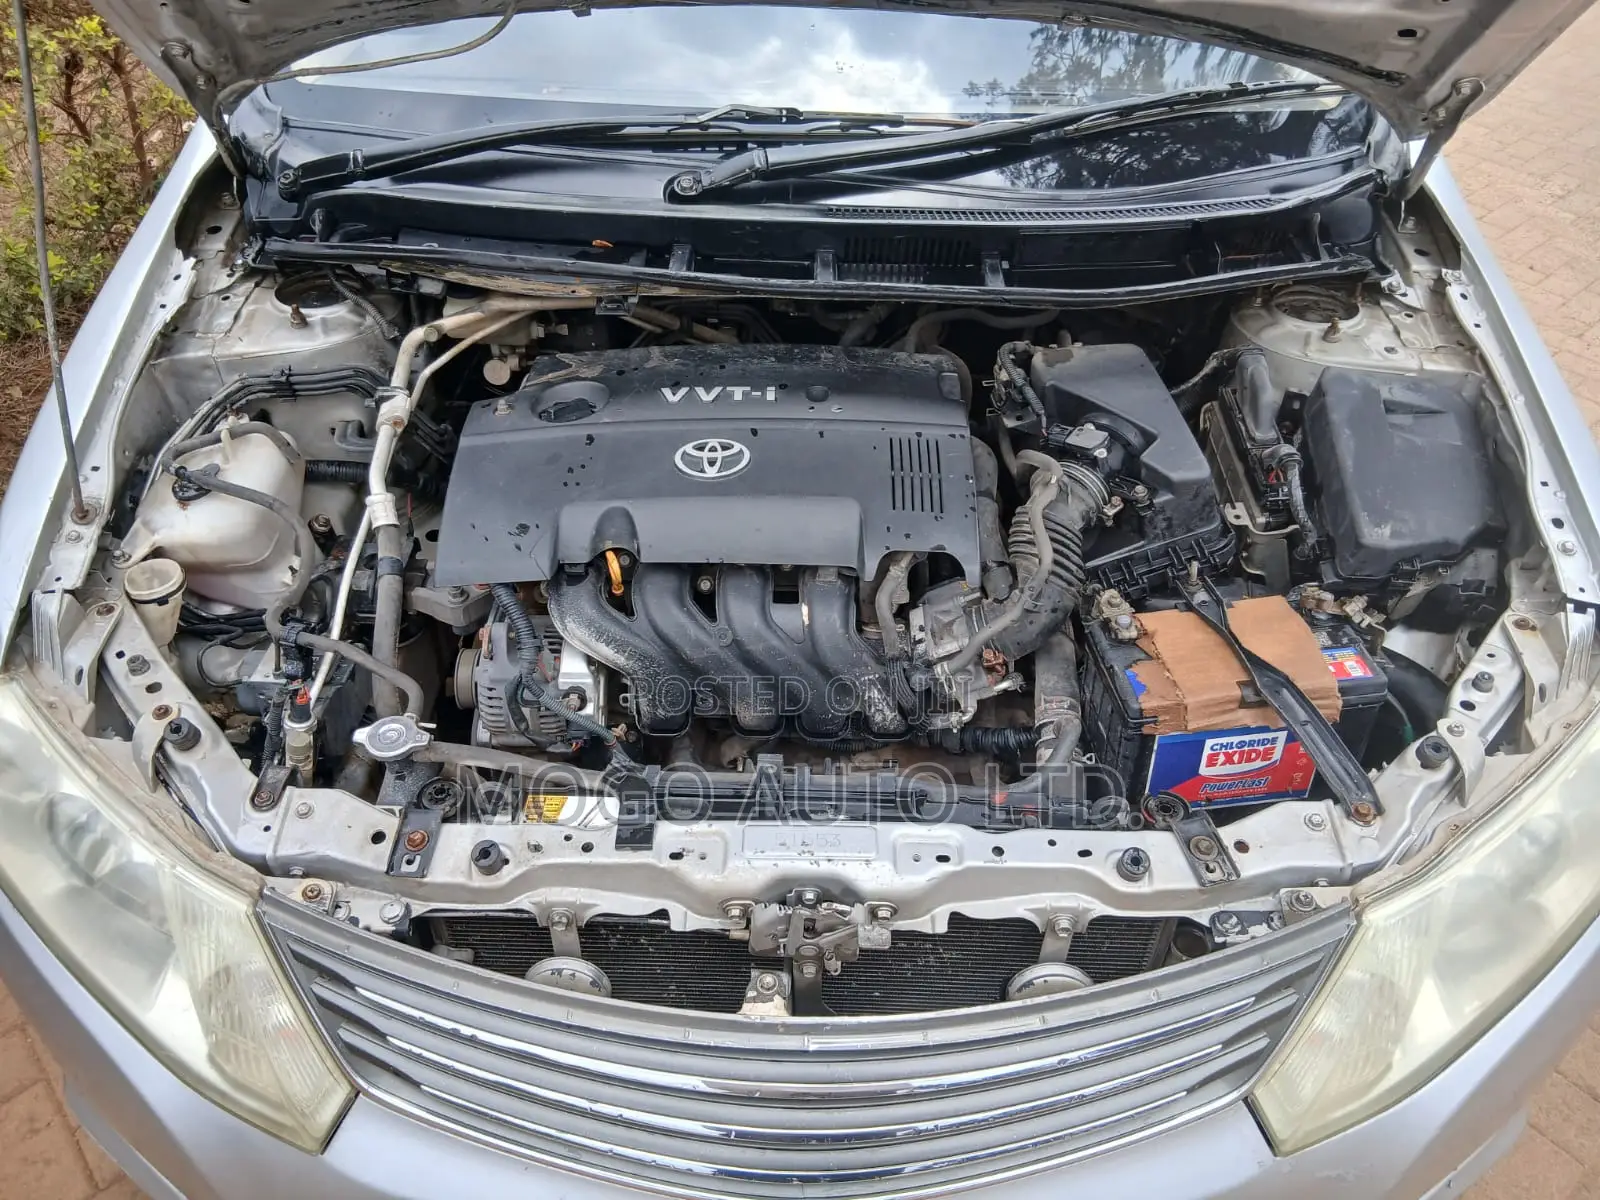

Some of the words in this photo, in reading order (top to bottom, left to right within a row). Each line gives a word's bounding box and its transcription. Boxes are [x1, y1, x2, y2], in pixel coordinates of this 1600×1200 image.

[660, 386, 777, 402] VVT-i
[1210, 736, 1279, 752] CHLORIDE
[1205, 746, 1277, 768] EXIDE
